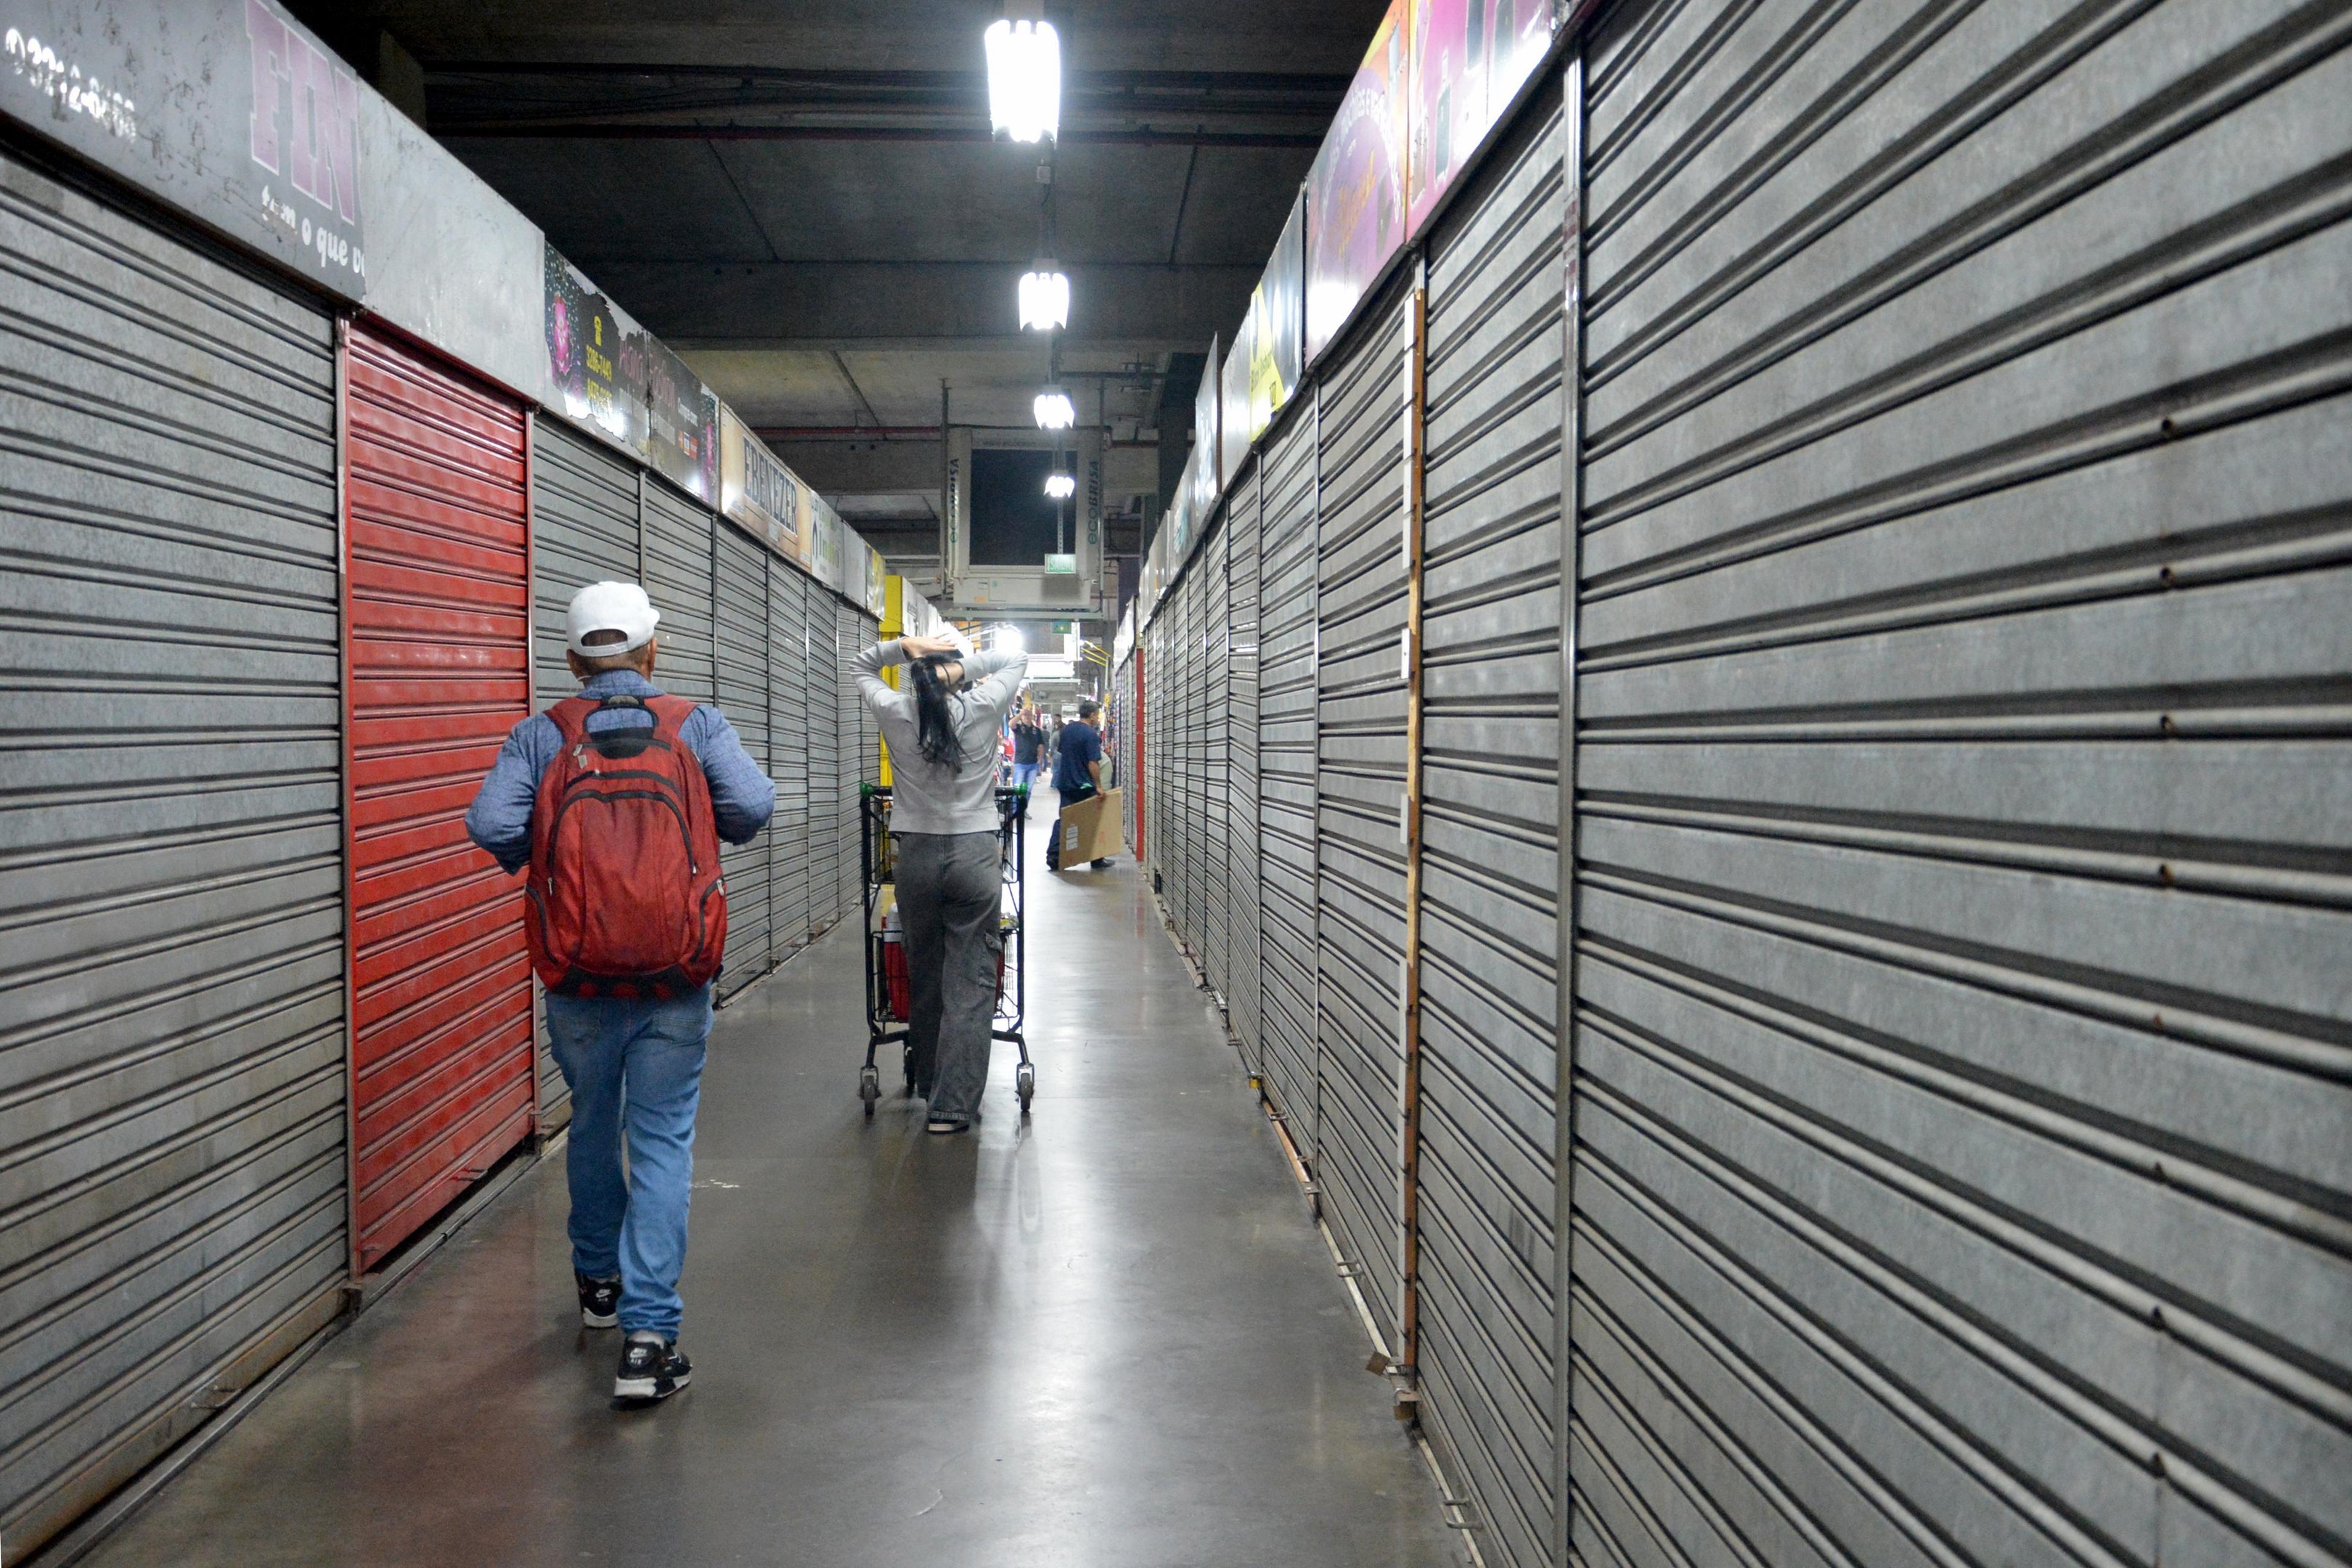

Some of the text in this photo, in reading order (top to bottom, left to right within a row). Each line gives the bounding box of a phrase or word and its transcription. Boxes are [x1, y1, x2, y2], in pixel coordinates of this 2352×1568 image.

[301, 218, 312, 245] o
[317, 226, 349, 268] que
[743, 436, 798, 536] EBENEZER
